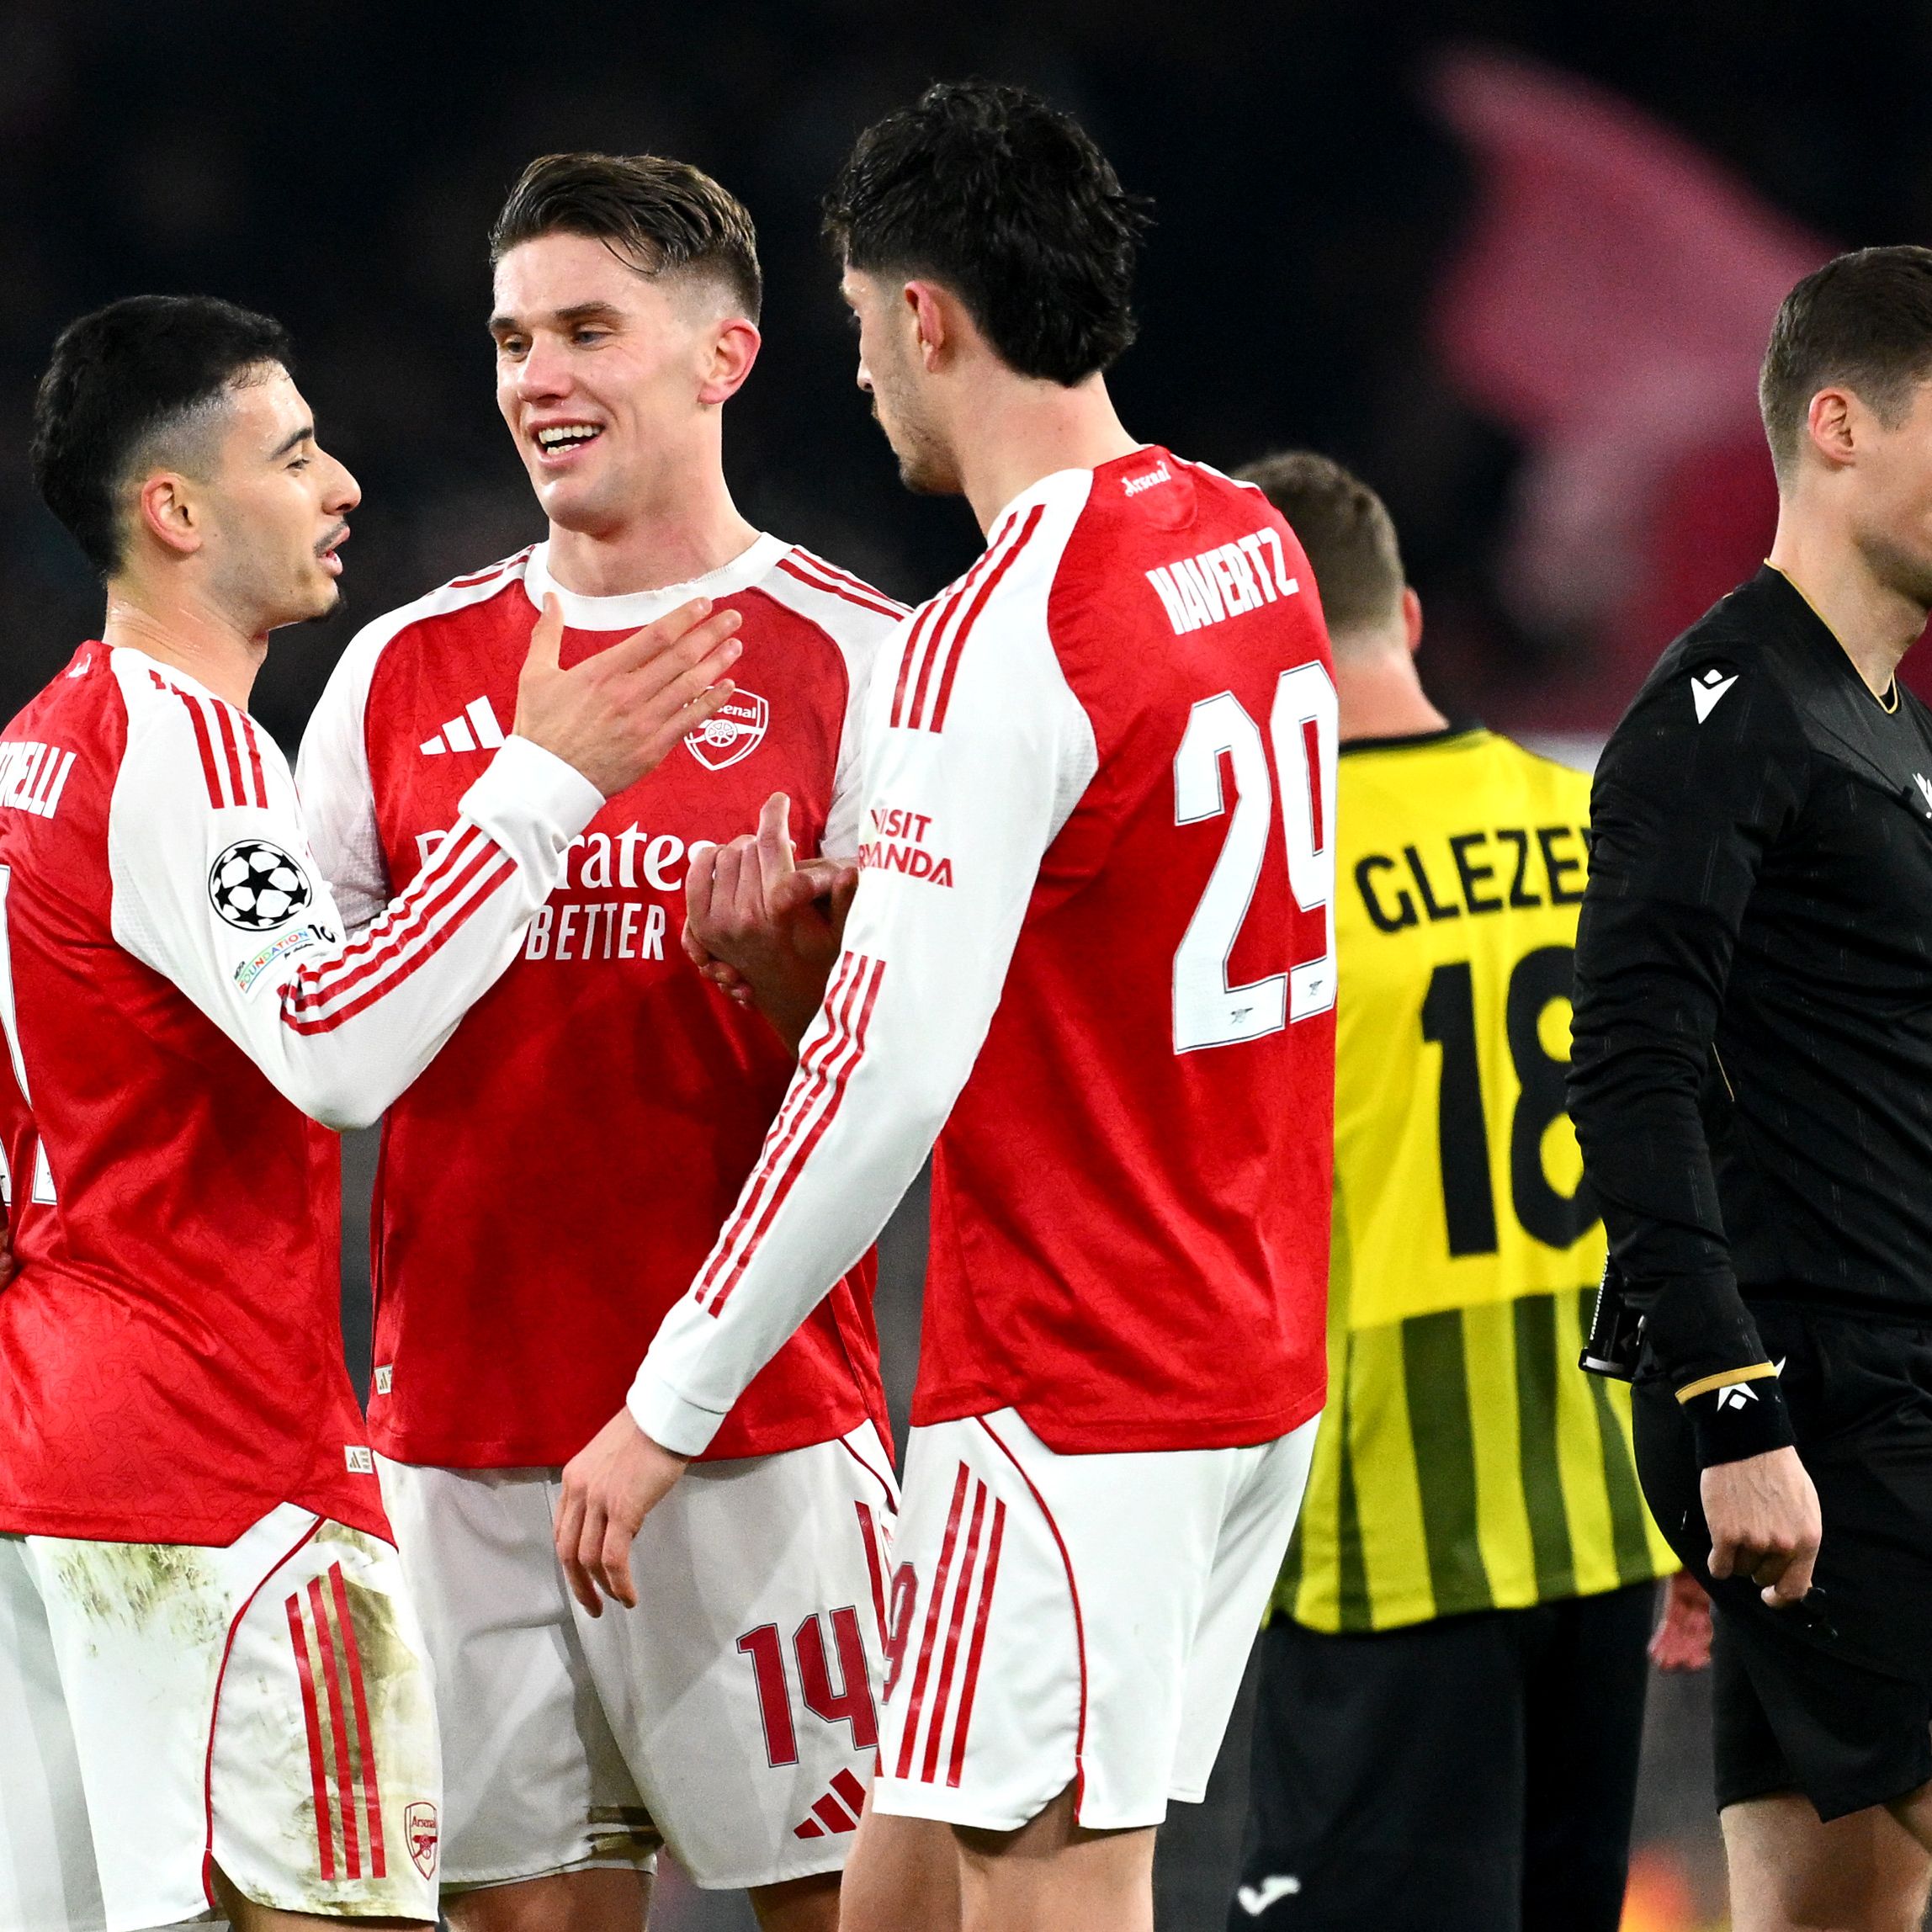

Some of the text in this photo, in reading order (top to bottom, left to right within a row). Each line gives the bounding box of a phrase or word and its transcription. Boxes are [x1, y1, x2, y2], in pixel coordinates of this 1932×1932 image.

[1121, 460, 1170, 497] Arsenal
[1144, 527, 1299, 635] HAVERTZ
[717, 704, 756, 719] enal
[1172, 660, 1338, 1054] 29
[1354, 825, 1591, 935] GLEZE
[239, 931, 309, 992] FOUNDATION
[525, 902, 666, 960] BETTER
[1420, 945, 1601, 1260] 18
[736, 1606, 878, 1768] 14
